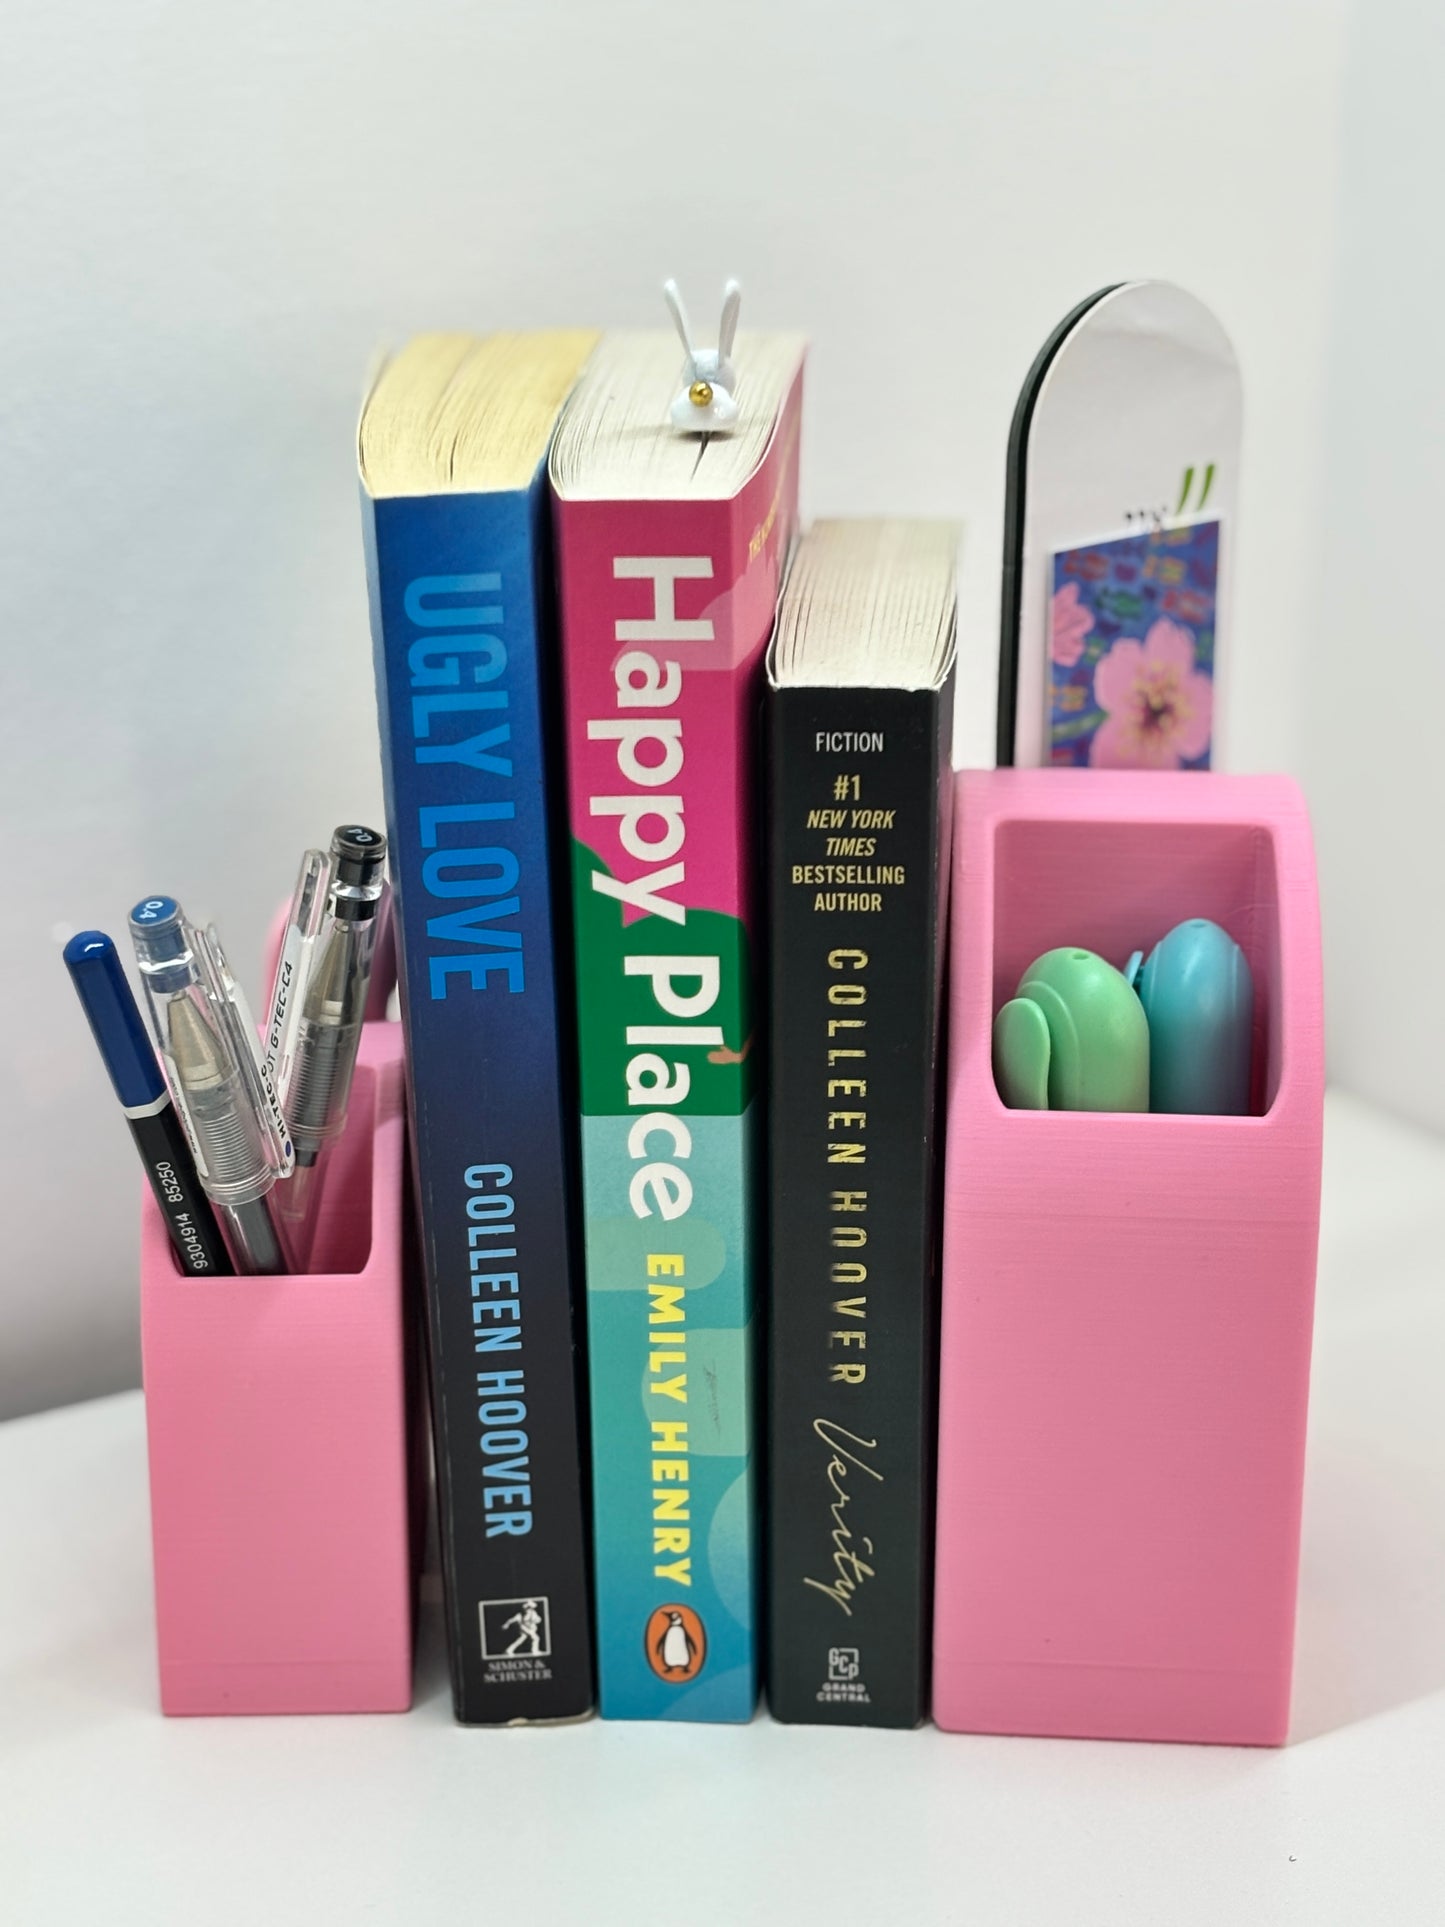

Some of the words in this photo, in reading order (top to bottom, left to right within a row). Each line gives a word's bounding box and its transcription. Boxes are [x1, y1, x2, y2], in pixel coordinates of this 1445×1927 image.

[403, 572, 513, 778] UGLY
[587, 555, 715, 927] Happy
[815, 731, 884, 752] FICTION
[806, 809, 848, 829] NEW
[850, 809, 896, 829] YORK
[833, 774, 861, 801] #1
[792, 865, 905, 885] BESTSELLING
[826, 837, 877, 857] TIMES
[139, 900, 164, 919] 0.4
[418, 801, 525, 1000] LOVE
[814, 893, 883, 912] AUTHOR
[269, 960, 293, 1050] G-TEC-C4
[623, 955, 725, 1221] Place
[827, 948, 869, 1164] COLLEEN
[261, 1064, 287, 1140] HI-TEC-C
[155, 1161, 184, 1203] 85250
[176, 1212, 209, 1270] 9304914
[463, 1162, 522, 1353] COLLEEN
[828, 1190, 869, 1385] HOOVER
[646, 1253, 687, 1404] EMILY
[476, 1369, 534, 1539] HOOVER
[650, 1421, 692, 1587] HENRY
[803, 1418, 884, 1616] Verity
[483, 1669, 552, 1683] SCHUSTER
[488, 1660, 533, 1672] SIMON
[534, 1659, 545, 1669] &
[816, 1691, 871, 1703] CENTRAL
[821, 1682, 866, 1693] GRAND
